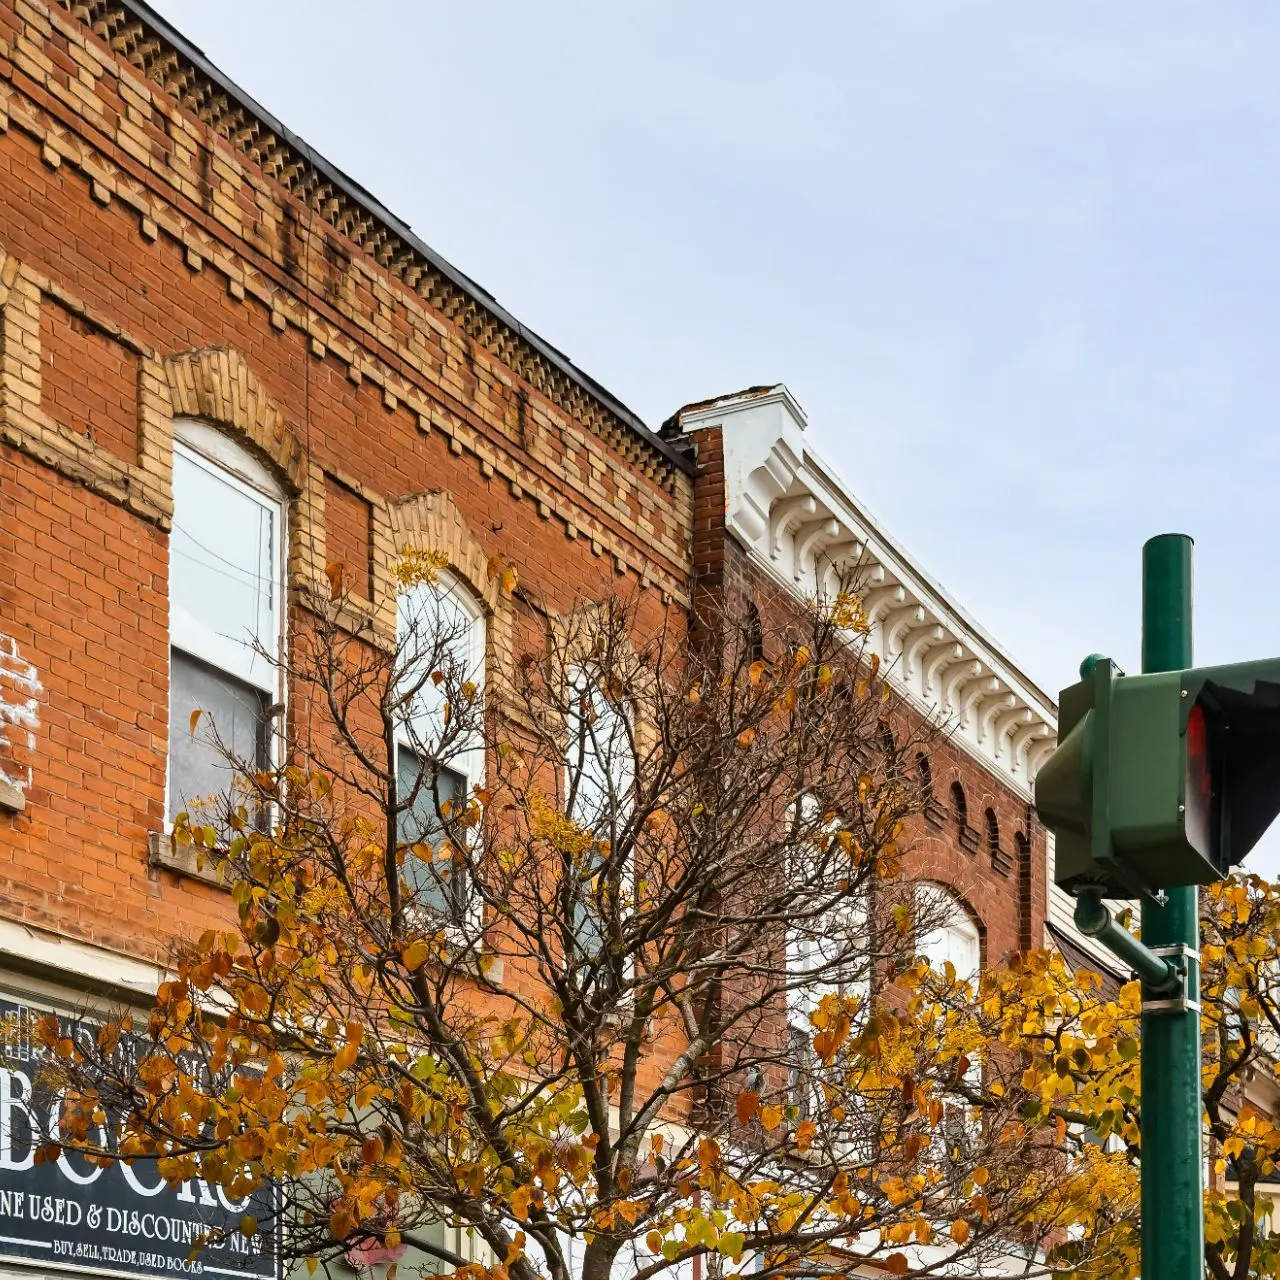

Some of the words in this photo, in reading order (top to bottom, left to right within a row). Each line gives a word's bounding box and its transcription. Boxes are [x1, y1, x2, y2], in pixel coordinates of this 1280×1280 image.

[30, 1193, 82, 1227] USED
[86, 1204, 101, 1229] &
[107, 1207, 225, 1250] DISCOUNTED
[229, 1231, 264, 1255] NEW
[167, 1257, 203, 1274] BOOKS
